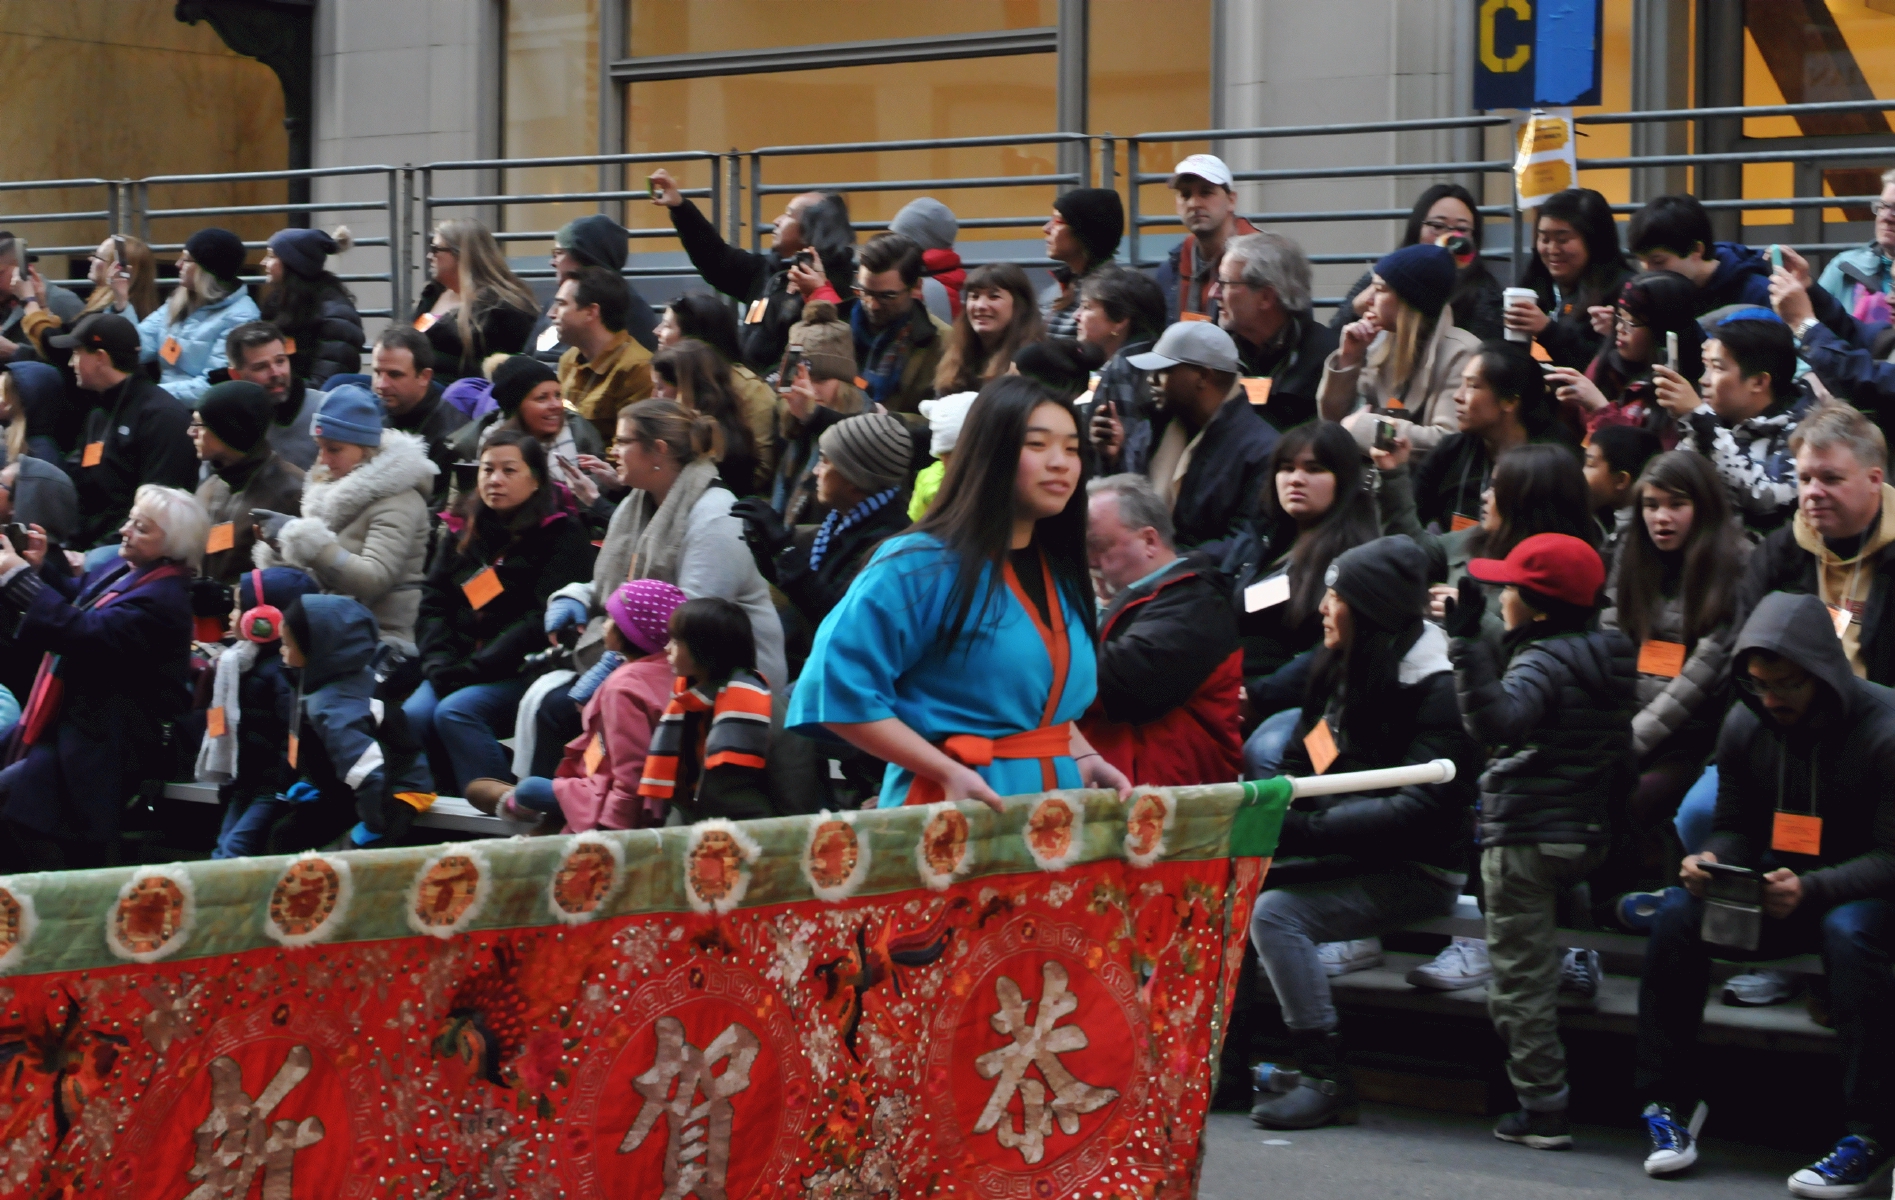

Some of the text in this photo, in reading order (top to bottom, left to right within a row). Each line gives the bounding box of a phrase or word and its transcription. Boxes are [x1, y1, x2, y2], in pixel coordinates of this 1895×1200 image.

[1480, 0, 1531, 73] C
[617, 1016, 762, 1200] 賀
[972, 960, 1121, 1164] 恭
